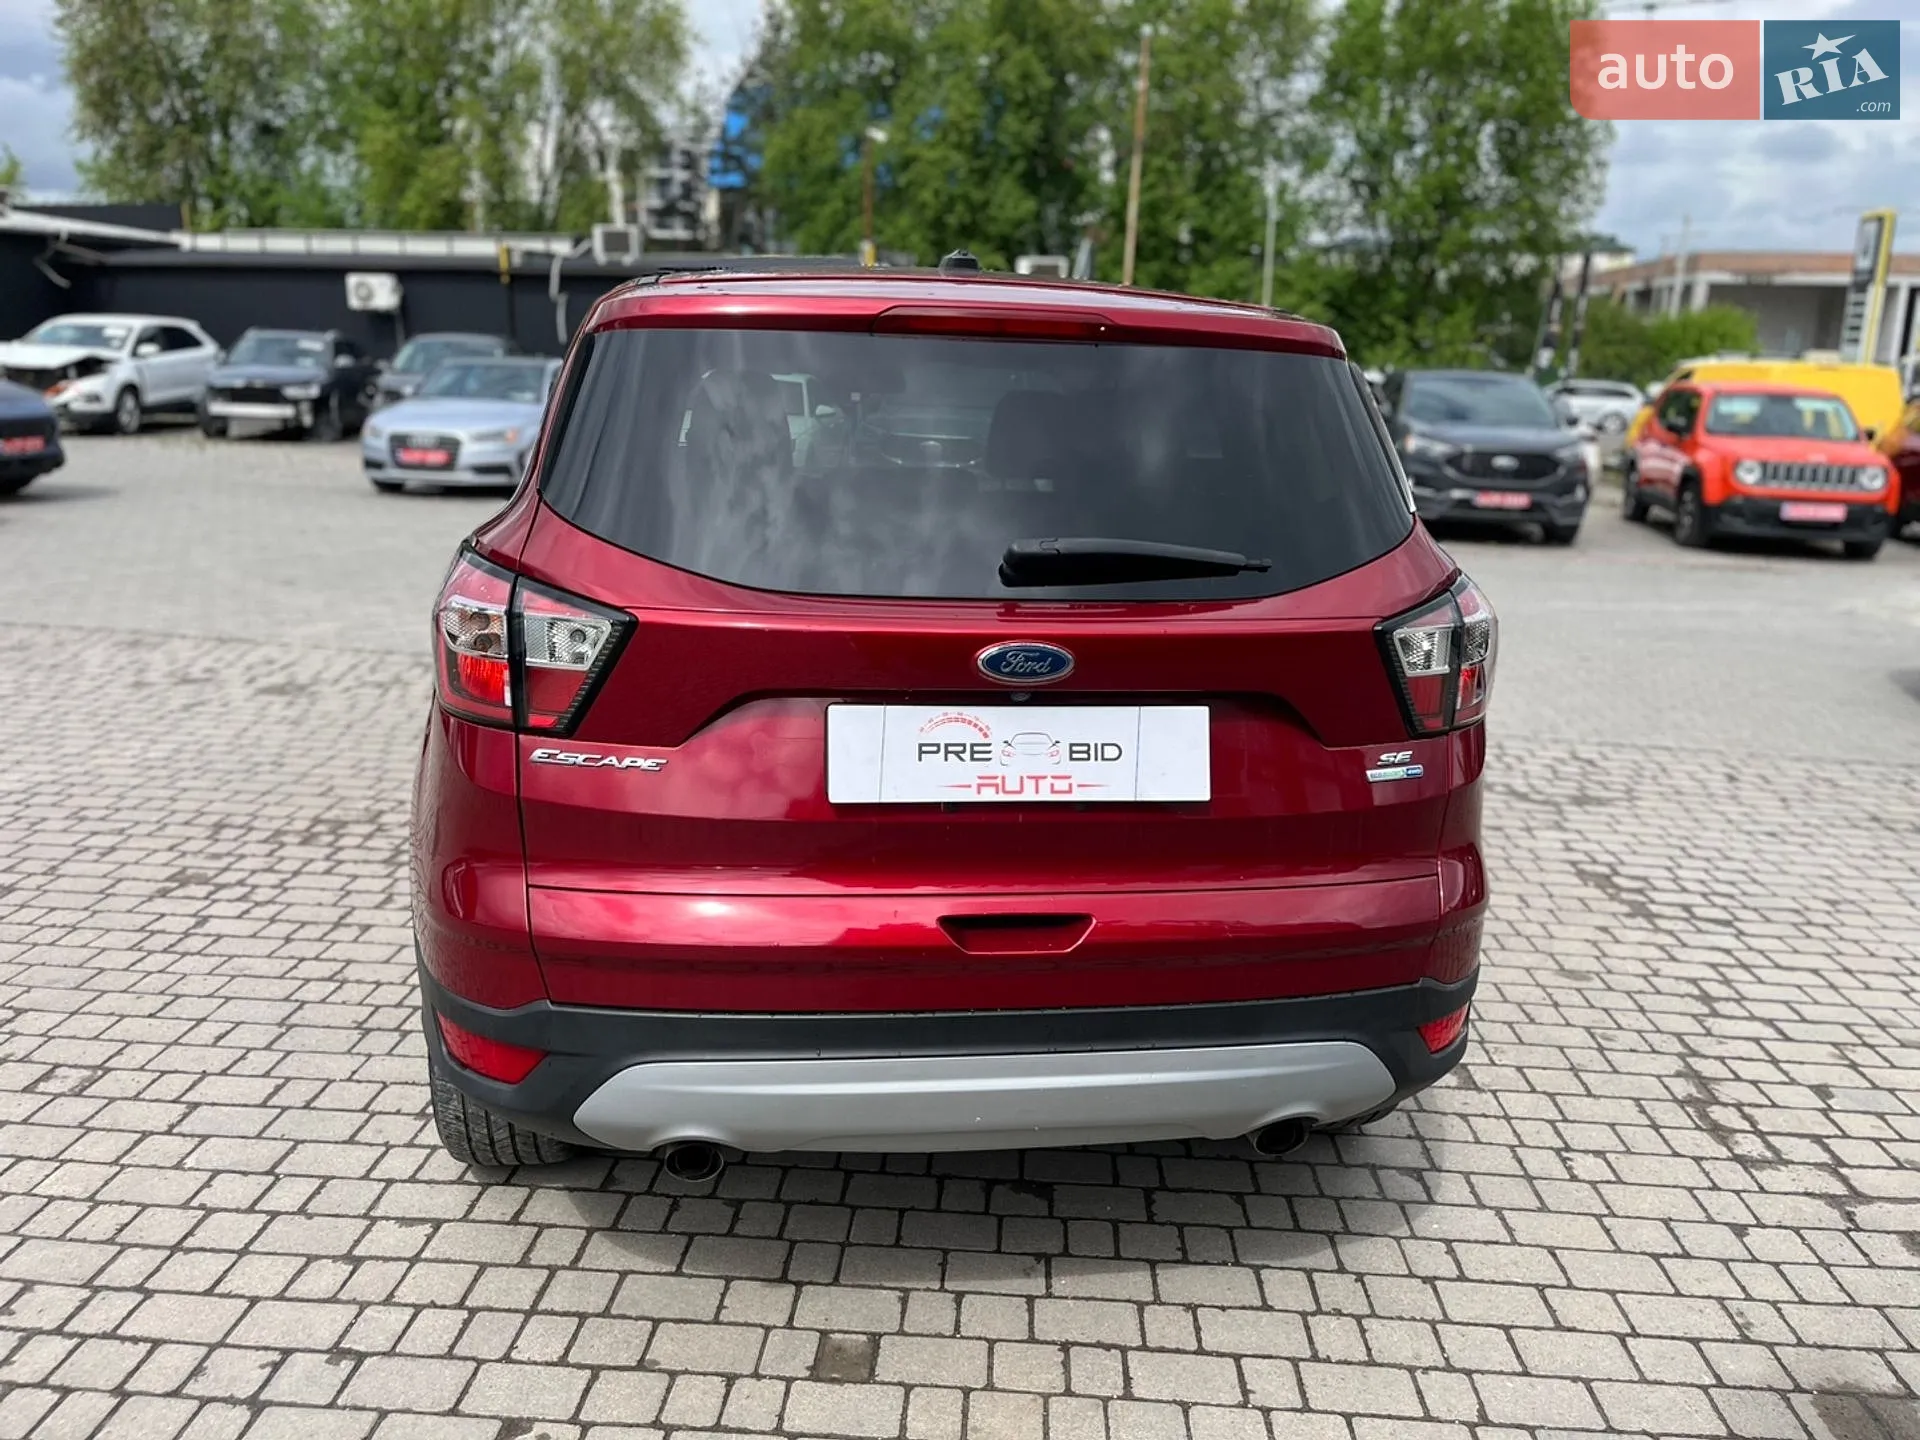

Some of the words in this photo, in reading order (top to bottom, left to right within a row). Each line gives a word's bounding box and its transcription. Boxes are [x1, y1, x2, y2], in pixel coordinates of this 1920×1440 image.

[1001, 651, 1052, 673] Ford
[529, 748, 667, 771] ESCAPE
[918, 743, 992, 762] PRE
[1069, 743, 1123, 762] BID
[1376, 750, 1413, 765] SE
[977, 775, 1073, 795] AUTO
